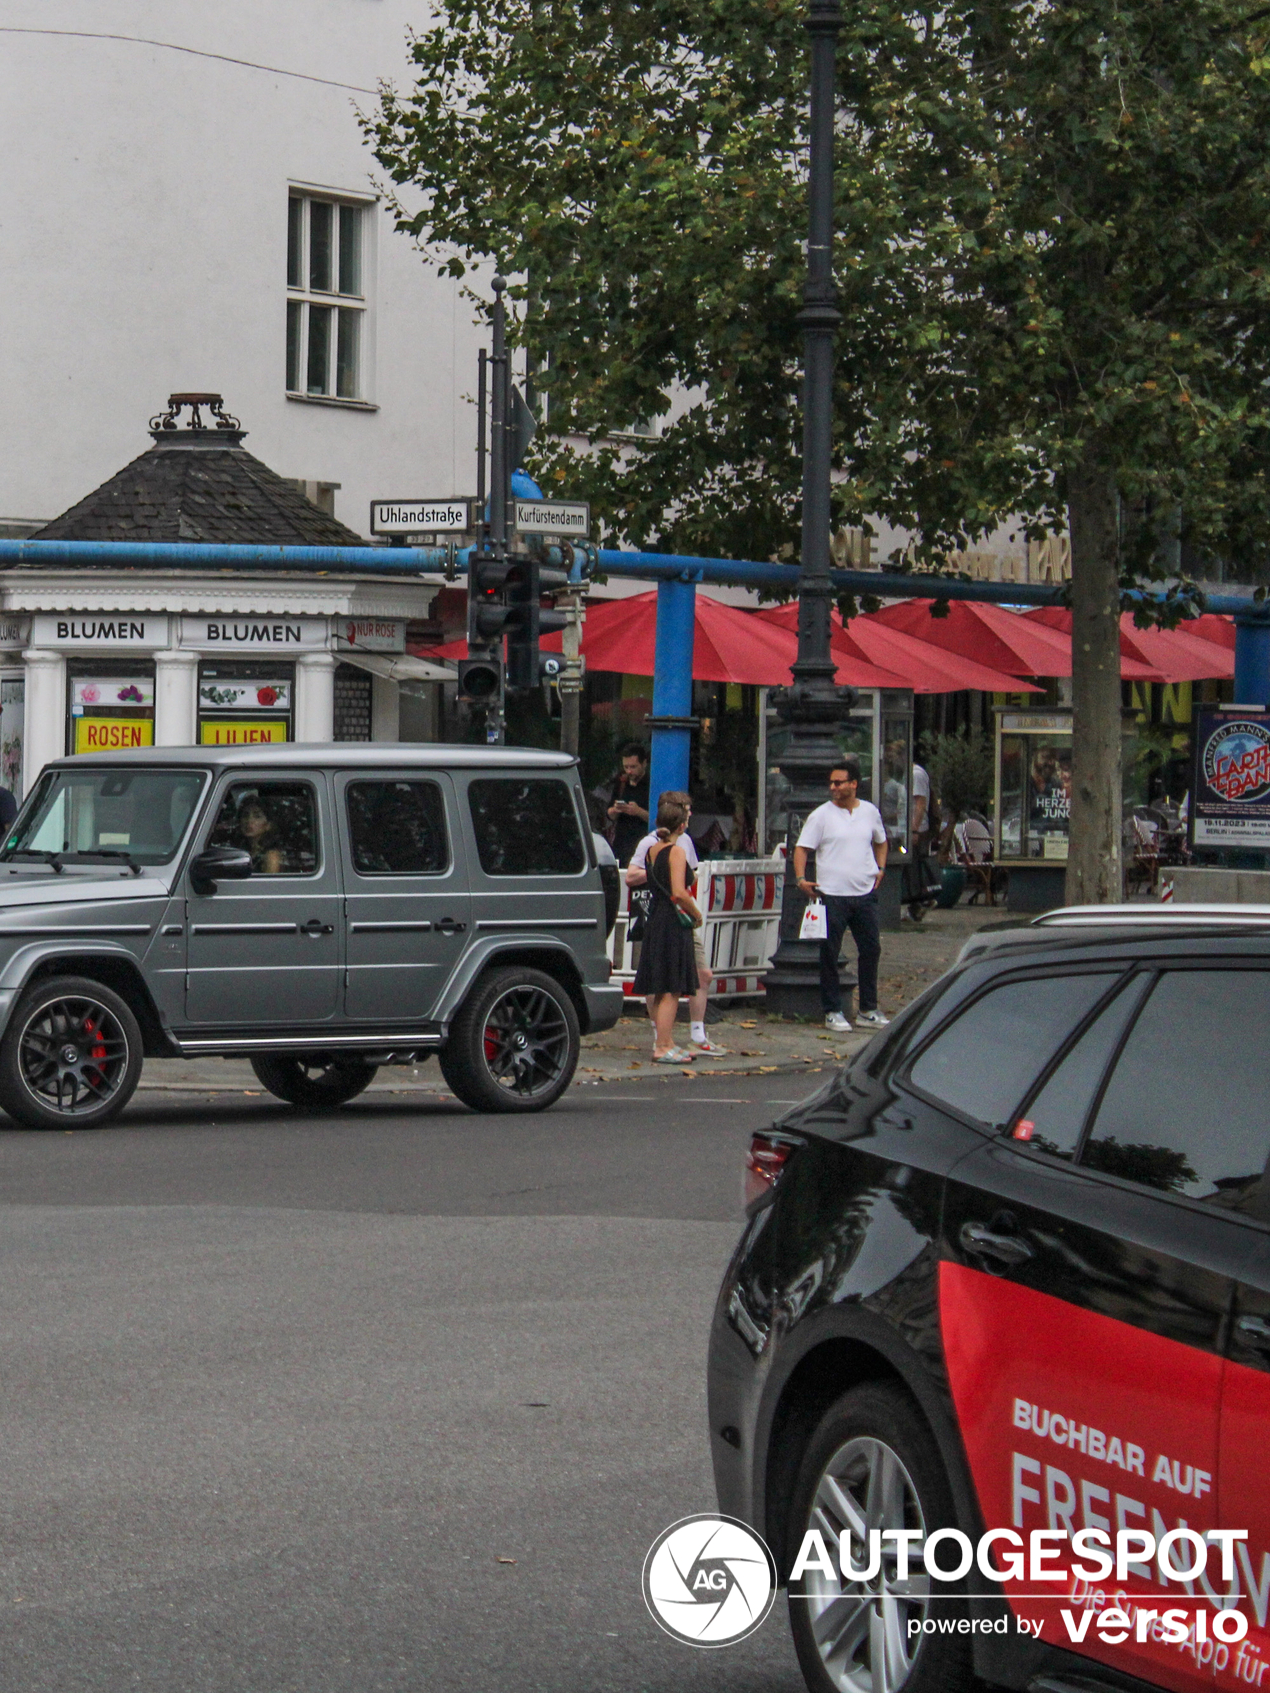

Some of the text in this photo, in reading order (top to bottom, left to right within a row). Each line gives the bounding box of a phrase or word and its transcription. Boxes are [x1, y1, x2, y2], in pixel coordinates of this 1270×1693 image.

[379, 506, 463, 526] Uhlandstraße
[517, 506, 585, 526] Kurfürstendamm
[57, 622, 145, 639] BLUMEN
[207, 624, 302, 643] BLUMEN
[356, 622, 396, 638] NUR ROSE
[87, 725, 142, 747] ROSEN
[1052, 788, 1067, 798] IM
[1013, 1397, 1212, 1499] BUCHBAR AUF
